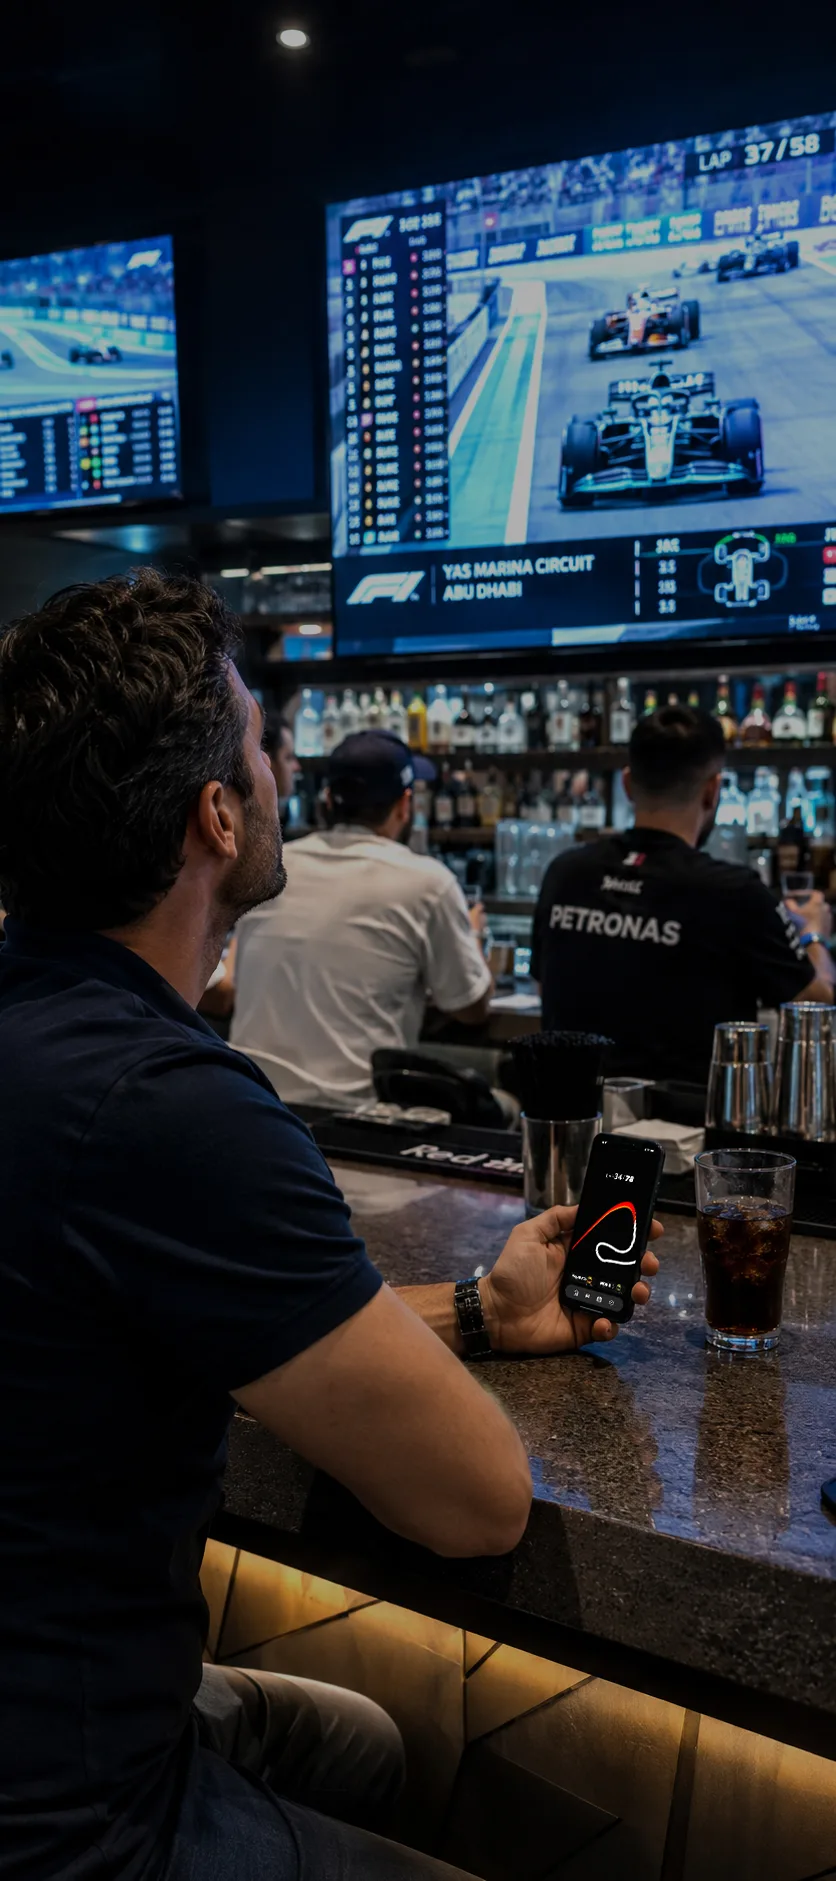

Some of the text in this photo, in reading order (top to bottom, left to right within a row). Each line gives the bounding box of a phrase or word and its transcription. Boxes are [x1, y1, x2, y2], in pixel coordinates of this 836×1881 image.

[699, 133, 821, 172] LAP 37/58
[442, 554, 596, 581] YAS MARINA CIRCUIT
[442, 580, 523, 601] ABU DHABI
[549, 904, 682, 946] PETRONAS
